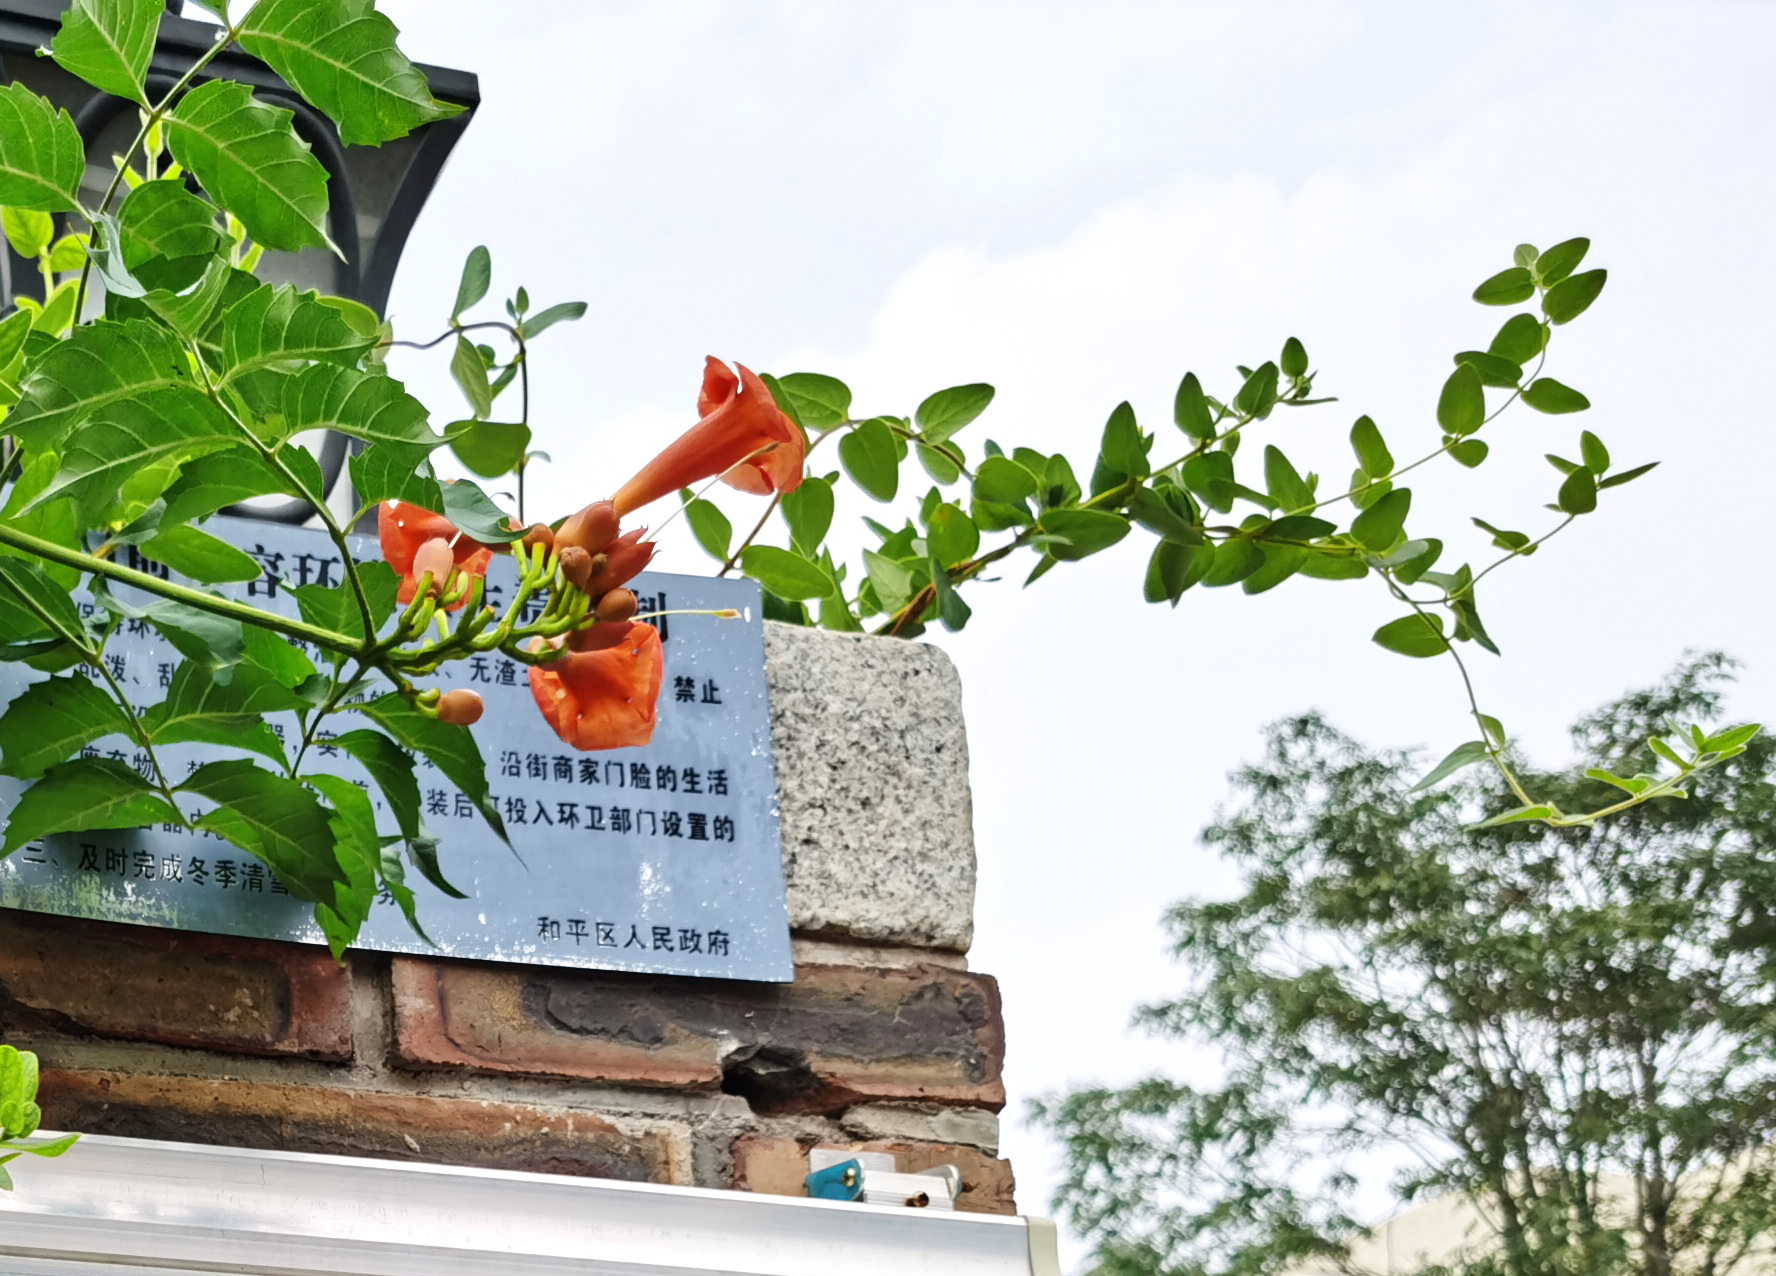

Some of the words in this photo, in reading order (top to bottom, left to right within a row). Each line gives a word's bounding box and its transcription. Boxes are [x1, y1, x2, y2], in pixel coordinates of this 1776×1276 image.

[674, 674, 723, 706] 禁止
[500, 750, 729, 797] 沿街商家门脸的生活
[537, 916, 731, 958] 和平区人民政府
